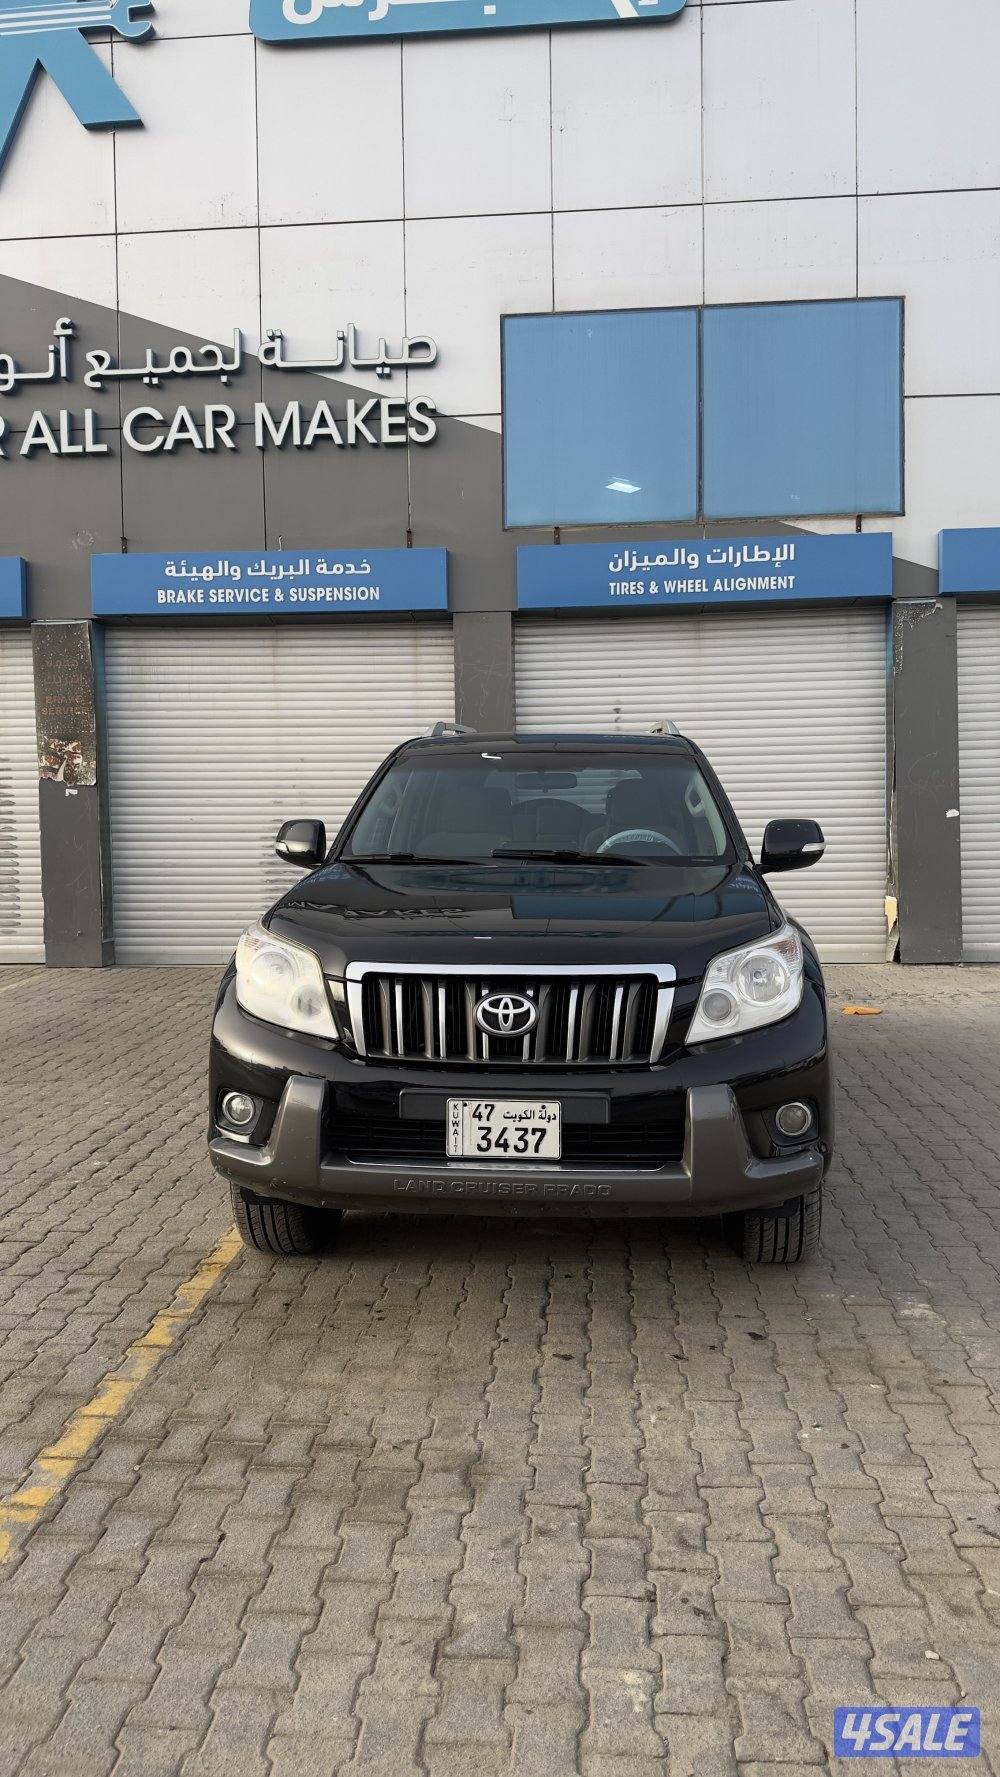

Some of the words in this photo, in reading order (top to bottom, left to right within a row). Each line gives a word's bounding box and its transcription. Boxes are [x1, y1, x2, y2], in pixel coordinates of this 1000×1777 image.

[84, 328, 242, 387] لجميع
[257, 323, 438, 377] صيانة
[20, 409, 108, 455] ALL
[123, 404, 236, 452] CAR
[254, 396, 437, 448] MAKES
[316, 558, 371, 575] خدمة
[609, 548, 699, 572] والميزان
[706, 544, 795, 568] الإطارات
[165, 560, 241, 581] والهيئة
[247, 559, 310, 580] البريك
[157, 589, 204, 603] BRAKE
[209, 588, 269, 603] SERVICE
[274, 588, 284, 602] &
[289, 586, 380, 601] SUSPENSION
[609, 582, 644, 596] TIRES
[649, 581, 659, 594] &
[664, 578, 708, 593] WHEEL
[713, 575, 795, 592] ALIGNMENT
[472, 1104, 495, 1121] 47
[503, 1109, 535, 1122] الكويت
[538, 1109, 557, 1123] دولة
[451, 1104, 460, 1153] KUWAIT
[477, 1126, 547, 1153] 3437
[393, 1179, 445, 1193] LAND
[451, 1181, 537, 1195] CRUISER
[543, 1183, 612, 1197] PRADO
